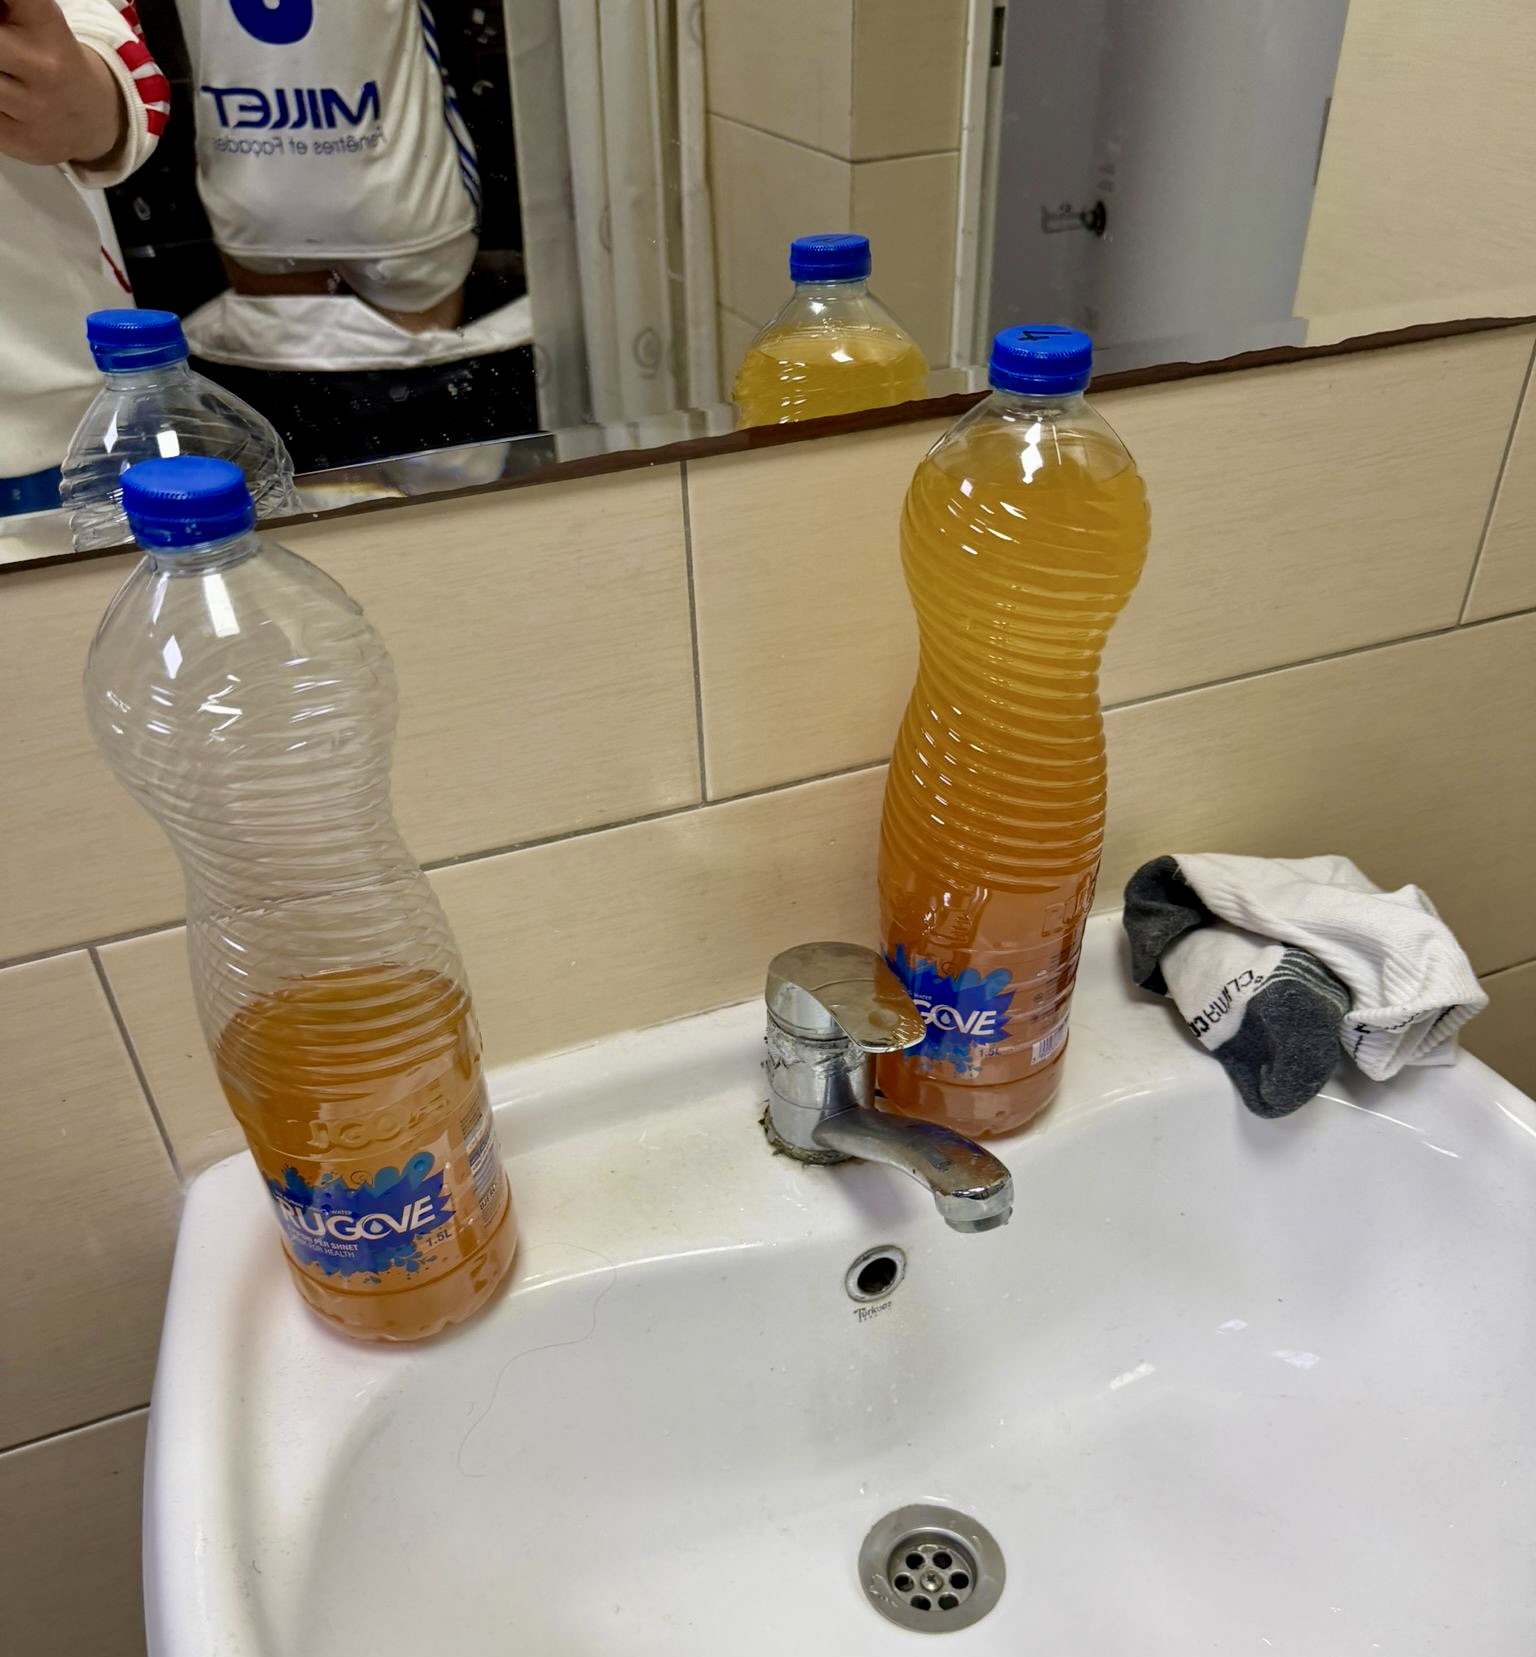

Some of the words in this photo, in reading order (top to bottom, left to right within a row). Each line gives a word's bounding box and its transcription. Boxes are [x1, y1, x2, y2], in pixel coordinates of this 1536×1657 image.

[912, 999, 997, 1035] GOVE
[426, 1229, 453, 1247] 1.5L
[324, 1248, 355, 1258] HEALTH
[331, 1242, 358, 1251] SHNET
